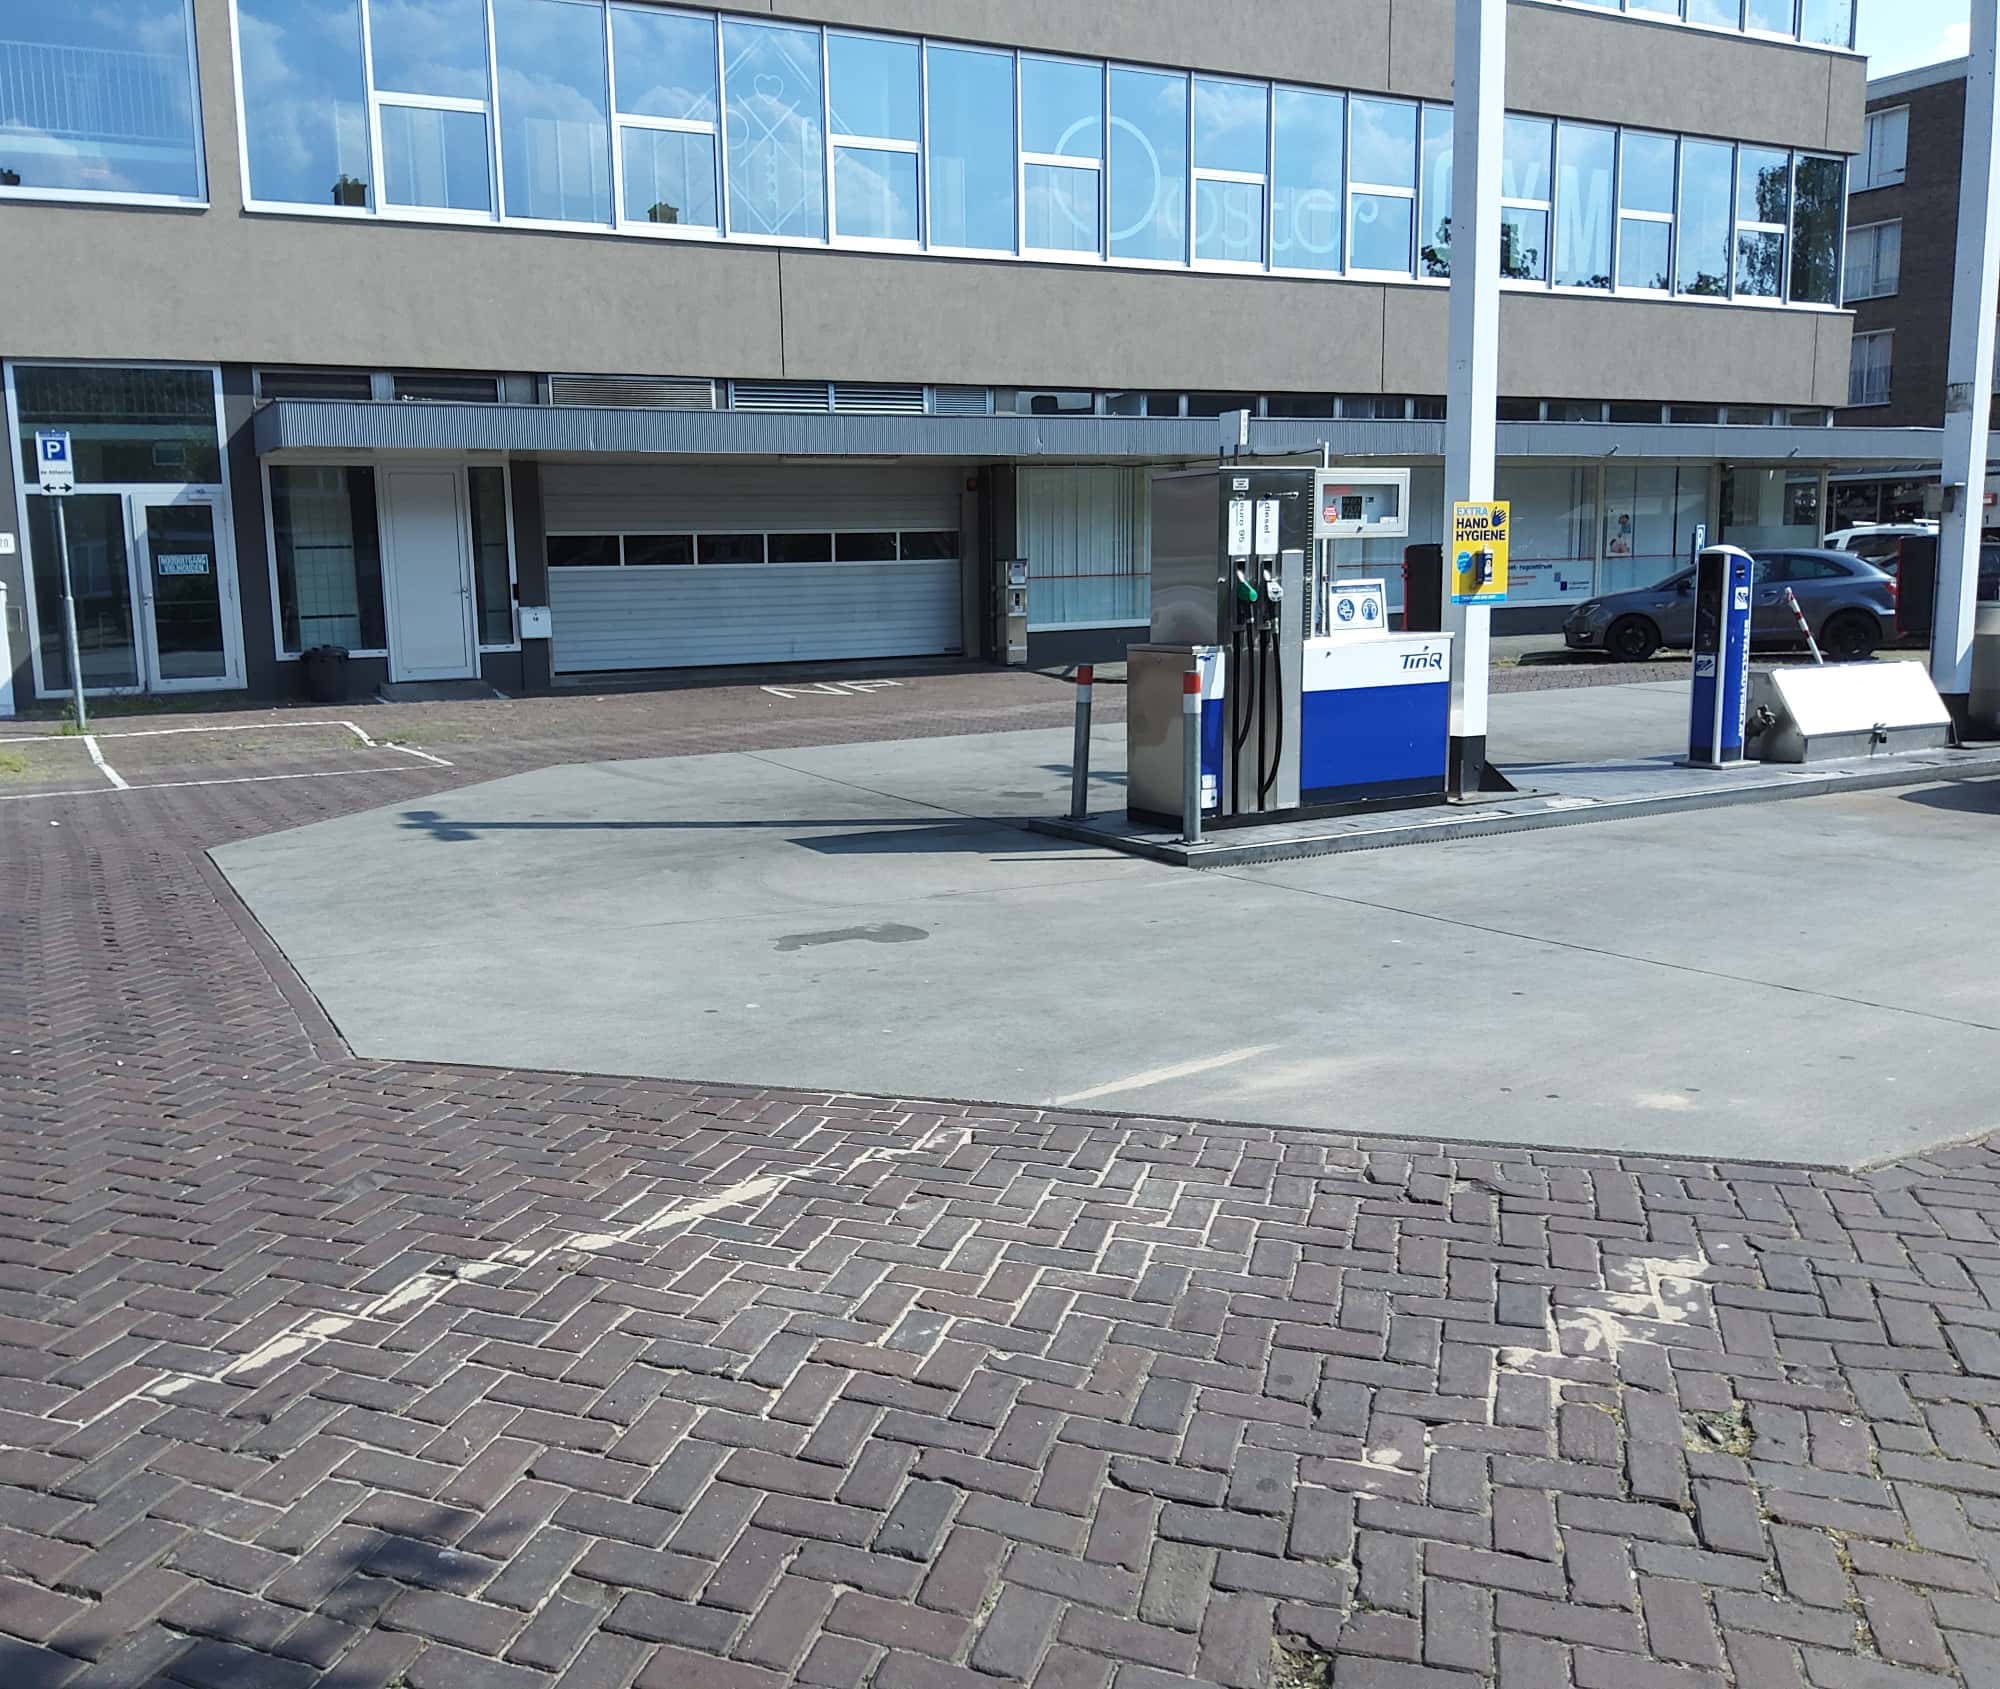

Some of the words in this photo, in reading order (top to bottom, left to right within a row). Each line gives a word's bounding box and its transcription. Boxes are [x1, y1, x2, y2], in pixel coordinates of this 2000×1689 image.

[47, 441, 61, 459] P
[1457, 507, 1488, 516] EXTRA
[1457, 518, 1489, 529] HAND
[1456, 530, 1506, 541] HYGIENE
[1400, 653, 1442, 670] TinQ
